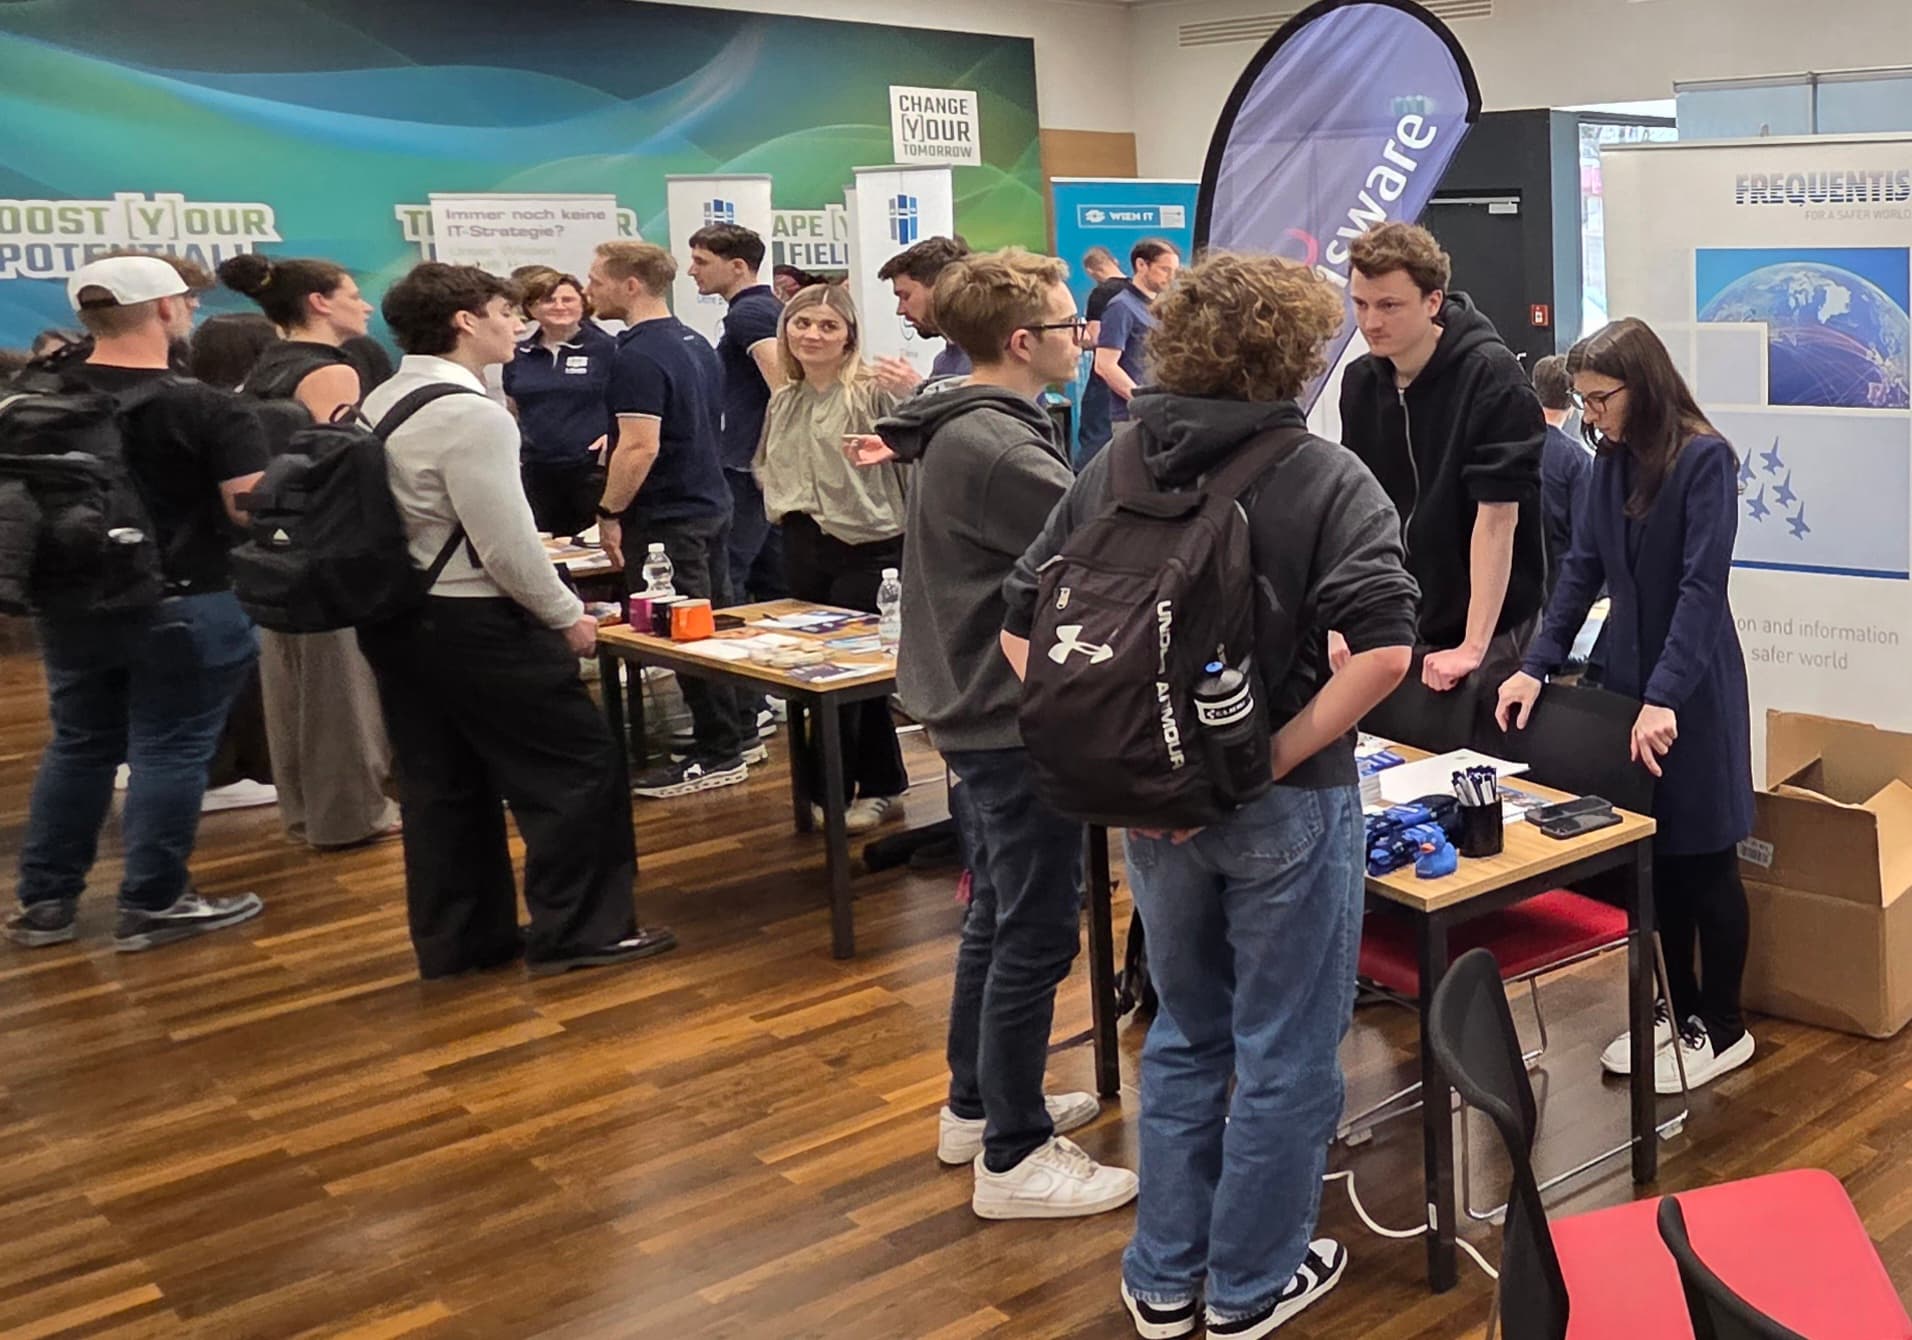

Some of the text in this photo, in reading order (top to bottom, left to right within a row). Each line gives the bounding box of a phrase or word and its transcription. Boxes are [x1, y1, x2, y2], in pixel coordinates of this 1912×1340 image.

[899, 94, 969, 115] CHANGE
[901, 113, 972, 143] [Y]OUR
[903, 143, 973, 158] TOMORROW
[1735, 170, 1912, 207] FREQUENTIS
[124, 199, 268, 240] [Y]OUR
[446, 209, 606, 221] Immer noch keine
[1805, 210, 1825, 221] FOR
[1836, 209, 1871, 221] SAFER
[1873, 208, 1912, 221] WORLD
[448, 224, 565, 240] IT-Strategie?
[789, 242, 849, 265] FIEL
[1762, 618, 1793, 635] and
[1799, 619, 1899, 645] information
[1751, 645, 1848, 670] safer world
